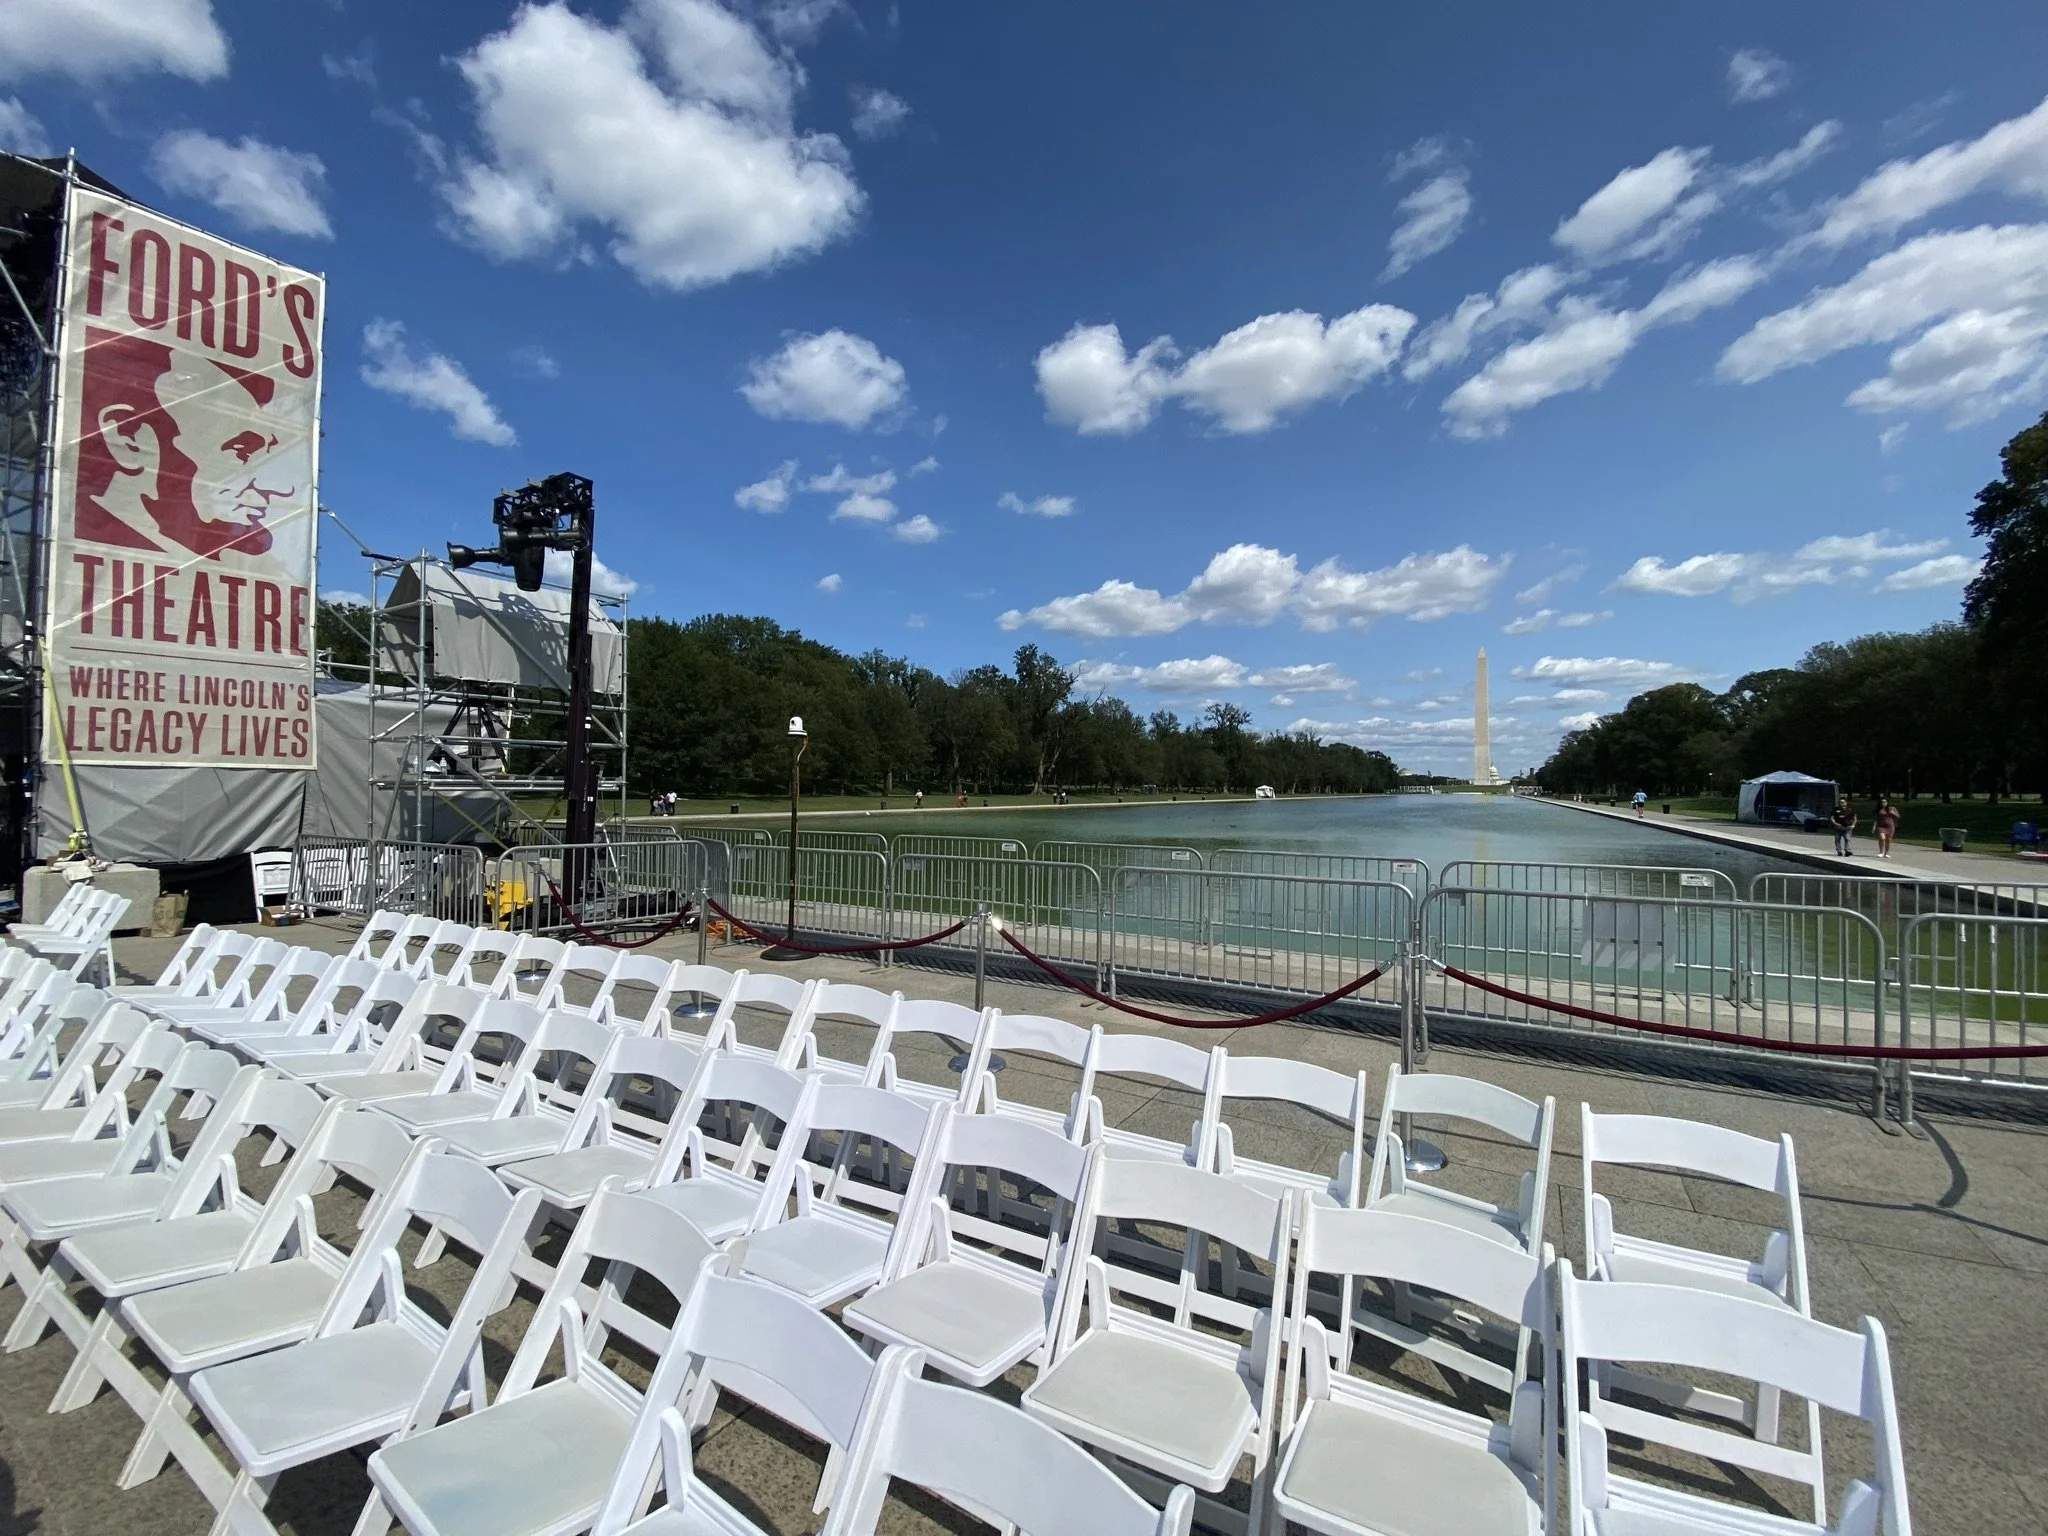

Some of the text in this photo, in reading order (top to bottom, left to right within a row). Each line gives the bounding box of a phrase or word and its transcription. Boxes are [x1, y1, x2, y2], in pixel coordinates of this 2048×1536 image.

[87, 211, 314, 378] FORD'S
[73, 553, 308, 657] THEATRE
[69, 665, 309, 712] WHERE LINCOLN'S
[65, 705, 308, 758] LEGACY LIVES
